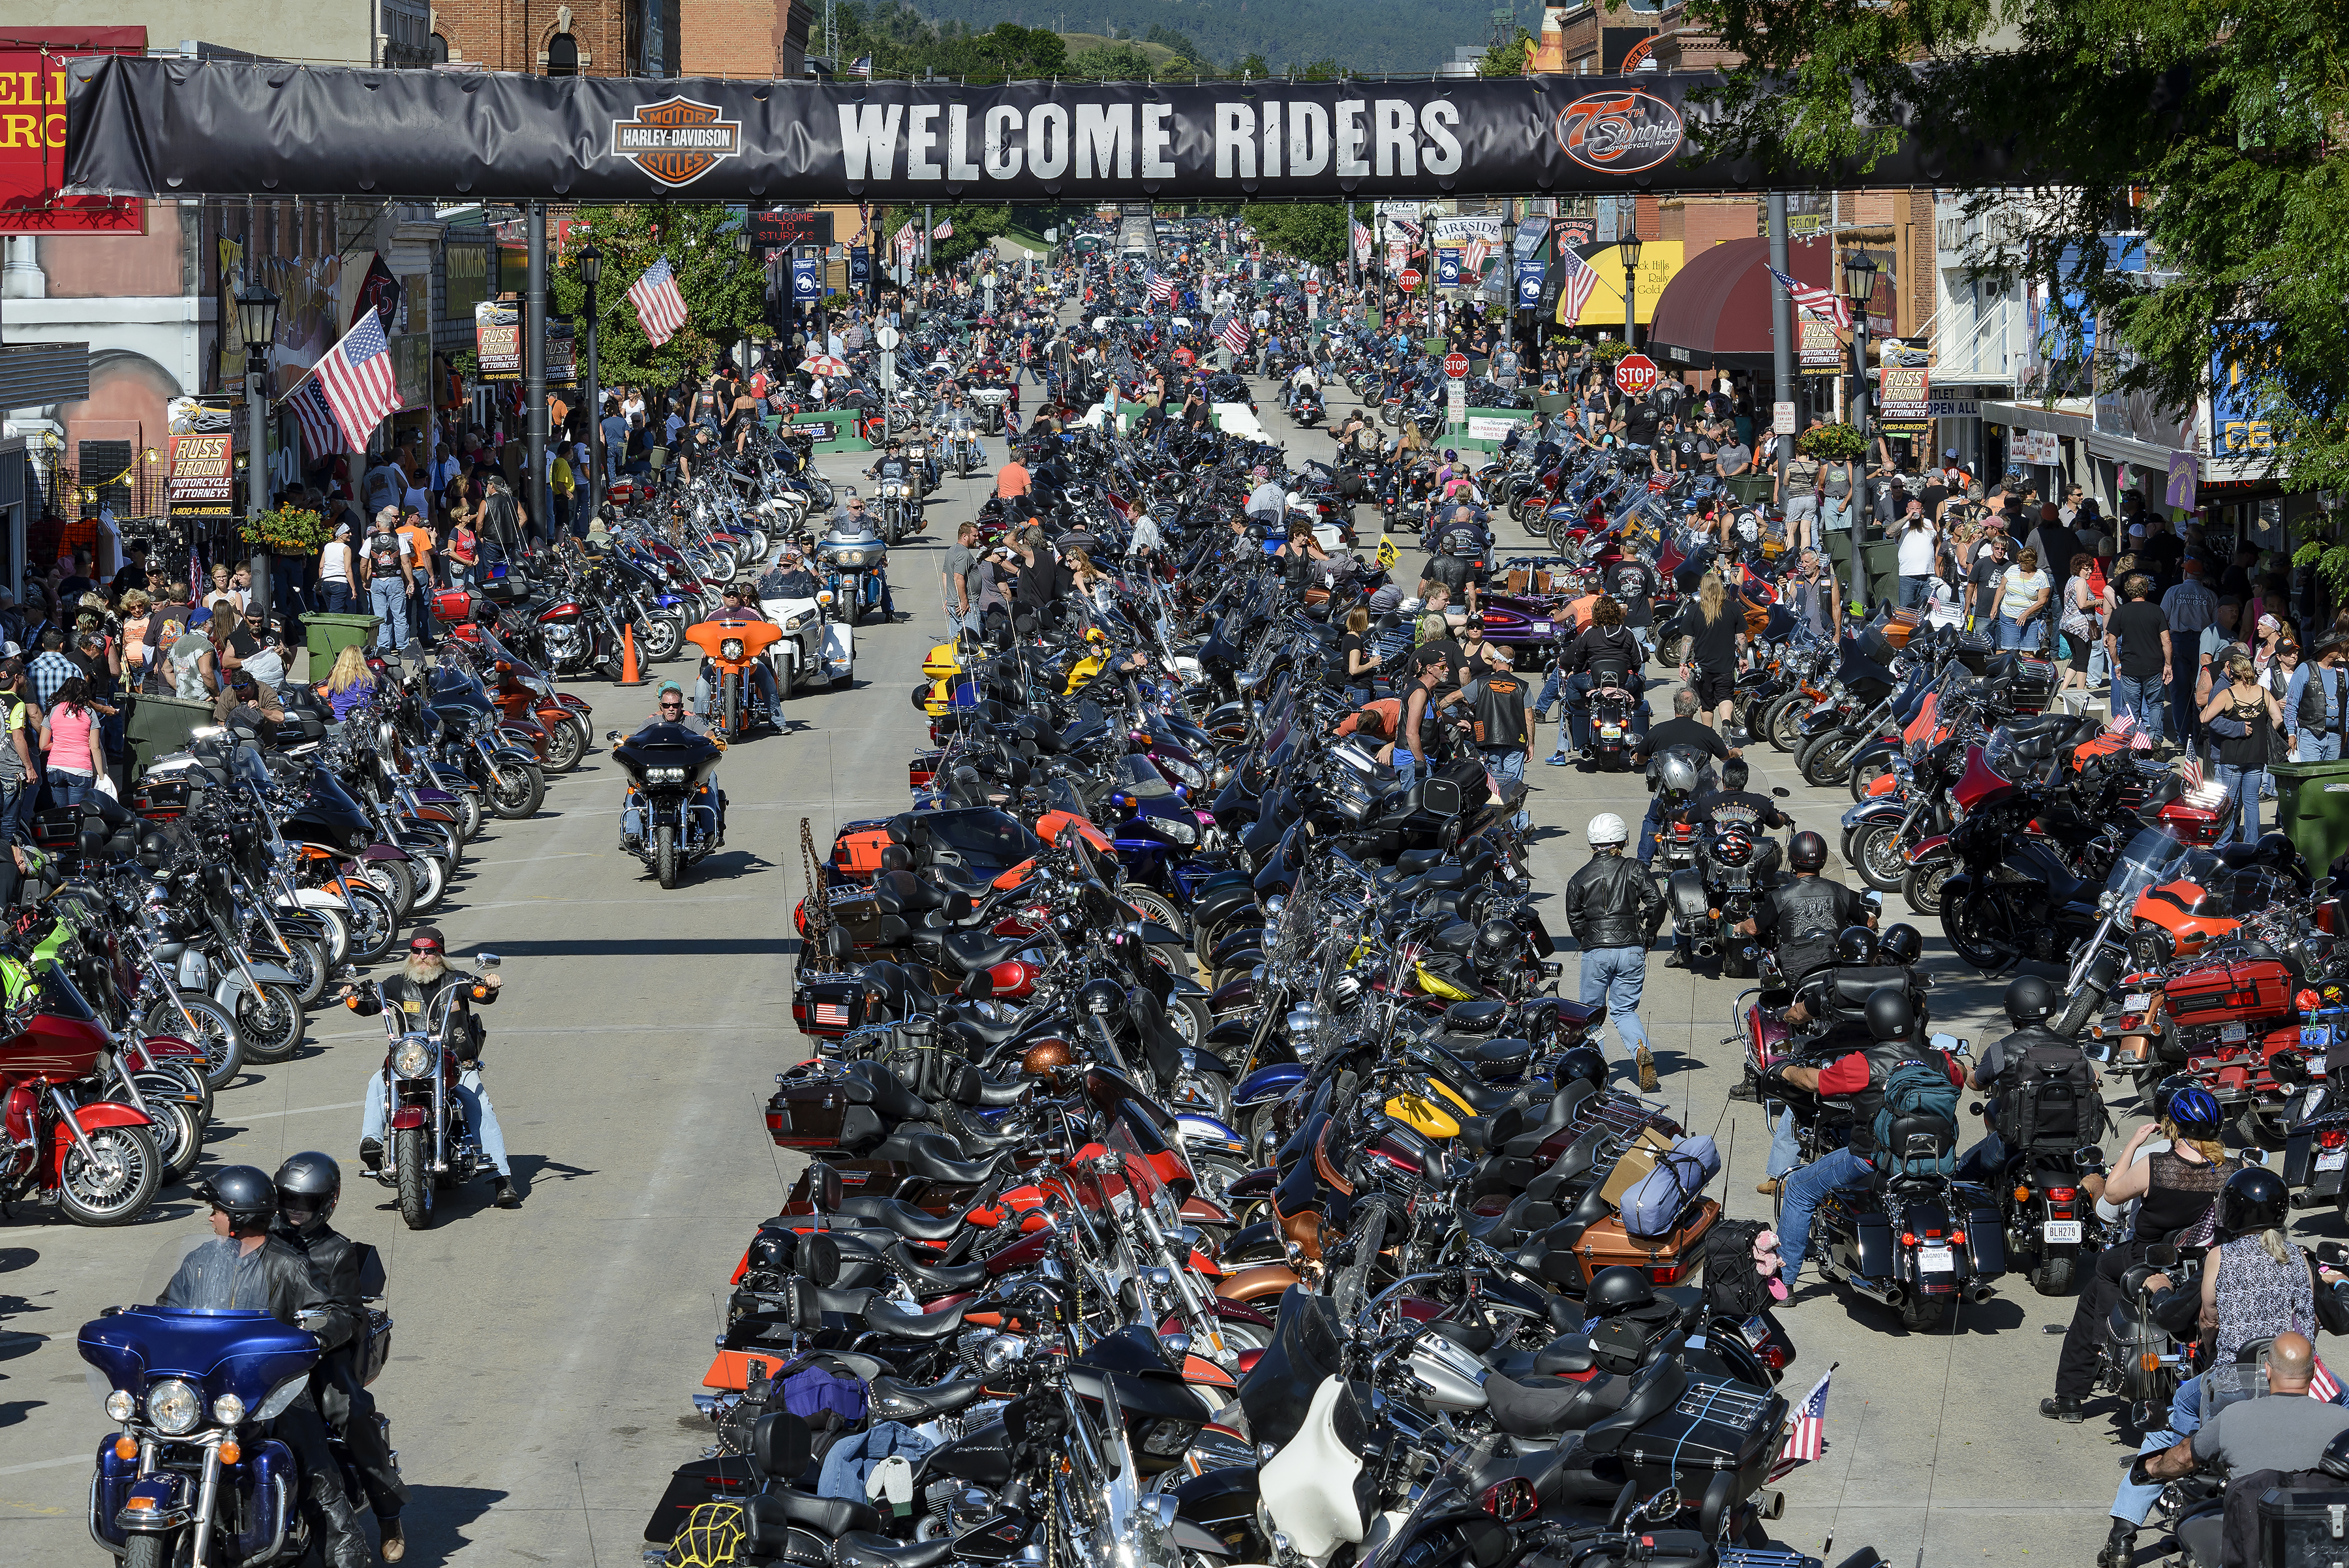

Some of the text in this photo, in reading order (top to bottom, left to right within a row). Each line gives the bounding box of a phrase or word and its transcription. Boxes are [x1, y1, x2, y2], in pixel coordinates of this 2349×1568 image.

[650, 106, 705, 123] MOTOR
[623, 129, 730, 146] HARLEY-DAVIDSON
[838, 99, 1462, 181] WELCOME RIDERS
[1597, 120, 1679, 149] Sturgis
[1604, 138, 1676, 153] MOTORCYCLE RALLY
[647, 153, 703, 176] CYCLES
[759, 213, 814, 222] WELCOME
[779, 223, 794, 231] TO
[1436, 221, 1500, 238] FIRESIDE
[1554, 222, 1593, 232] STURGIS
[759, 231, 814, 240] STURGIS
[448, 248, 487, 279] STURGIS
[1652, 260, 1669, 270] Hills
[1400, 276, 1420, 285] STOP
[1648, 273, 1670, 286] Rally
[480, 328, 517, 344] RUSS
[1801, 324, 1836, 337] RUSS
[480, 343, 517, 356] BROWN
[1801, 338, 1837, 349] BROWN
[479, 354, 519, 363] MOTORCYCLE
[547, 354, 574, 366] ROWN
[1445, 361, 1467, 370] STOP
[1618, 367, 1655, 383] STOP
[1883, 370, 1926, 388] RUSS
[1882, 387, 1927, 400] BROWN
[1928, 402, 1977, 414] OPEN ALL
[173, 437, 228, 460] RUSS
[172, 459, 228, 477] BROWN
[170, 478, 231, 487] MOTORCYCLE
[172, 488, 229, 498] ATTORNEYS
[172, 507, 231, 515] 1-800-4-BIKERS
[2050, 1227, 2076, 1237] BLH279
